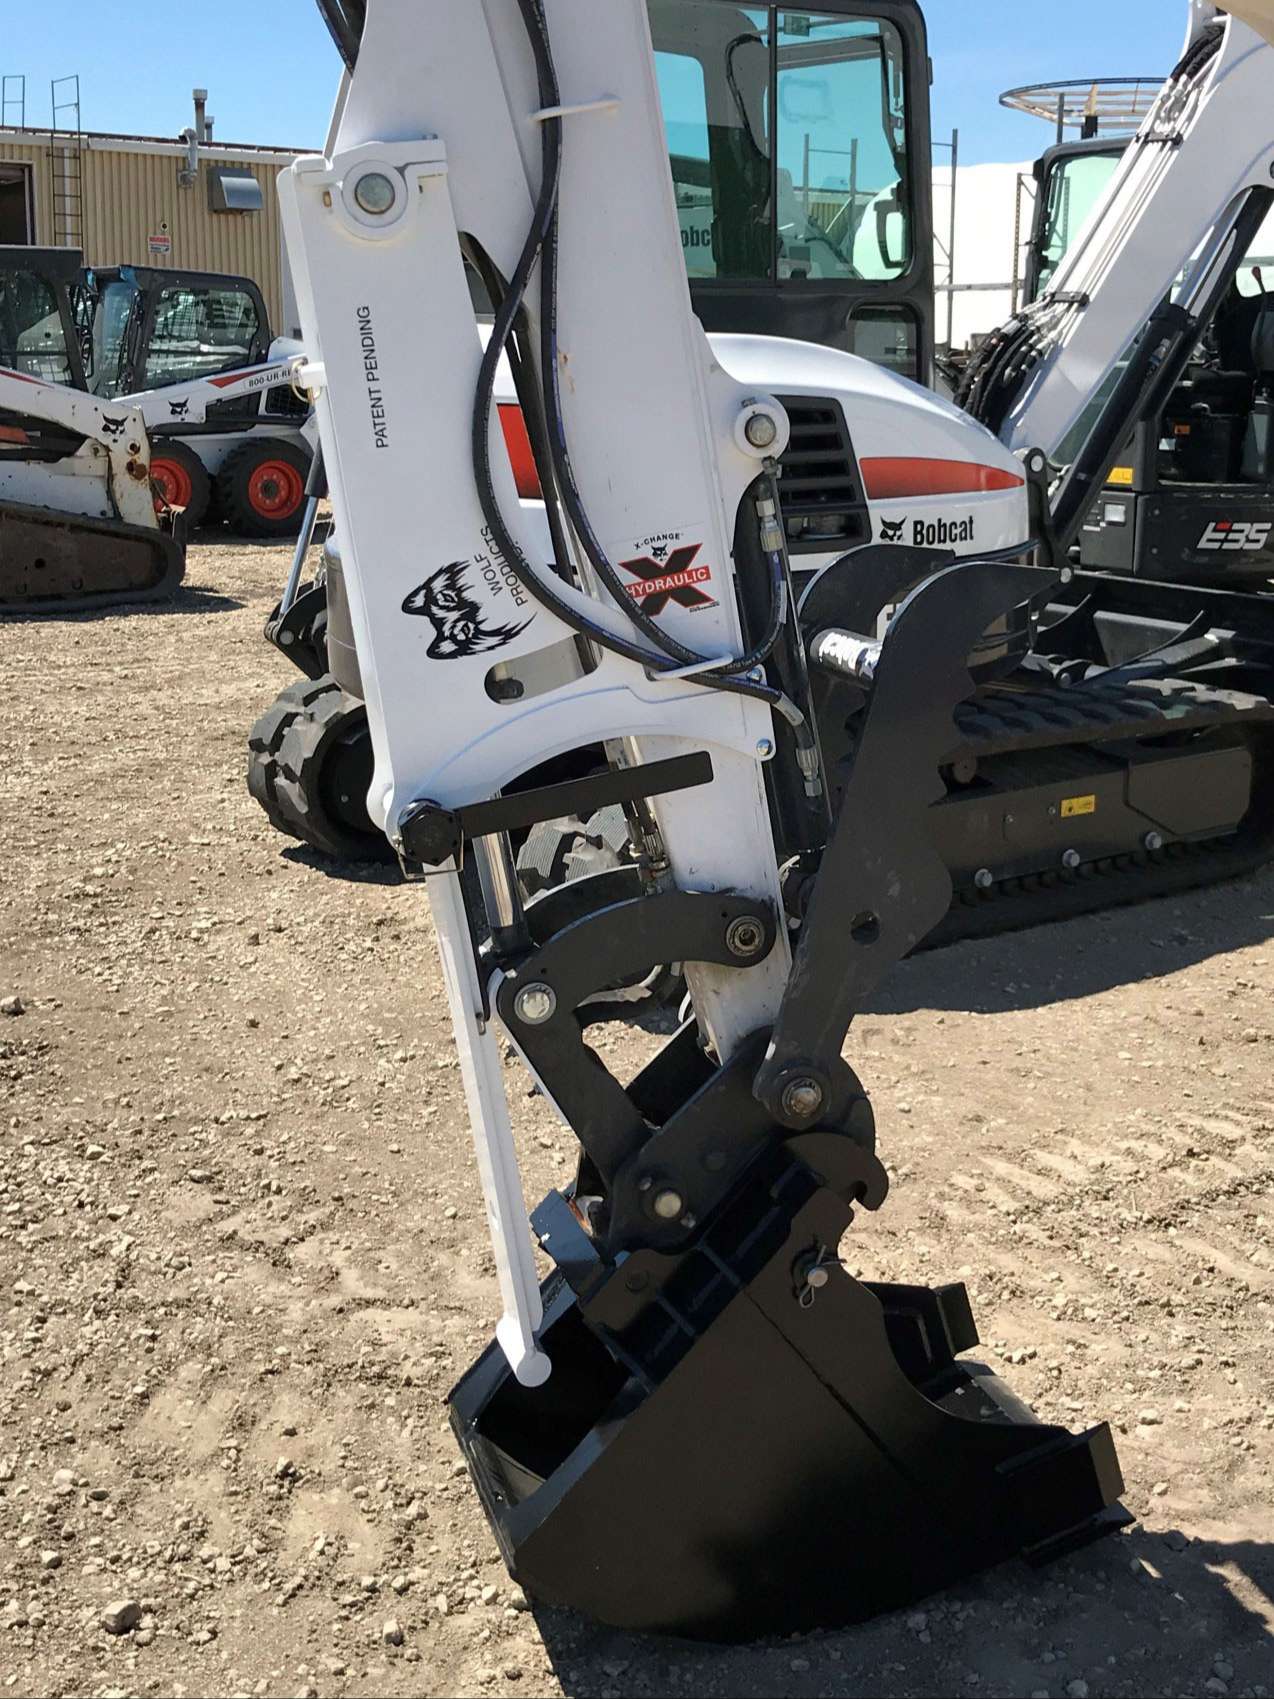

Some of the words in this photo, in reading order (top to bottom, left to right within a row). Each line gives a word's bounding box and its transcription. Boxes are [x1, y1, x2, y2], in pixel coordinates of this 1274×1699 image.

[356, 305, 380, 382] PENDING
[367, 386, 389, 449] PATENT
[634, 531, 681, 550] X-CHANGE
[912, 515, 974, 546] Bobcat
[1196, 521, 1272, 550] E35
[473, 553, 503, 597] WOLF
[626, 568, 707, 597] HYDRAULIC
